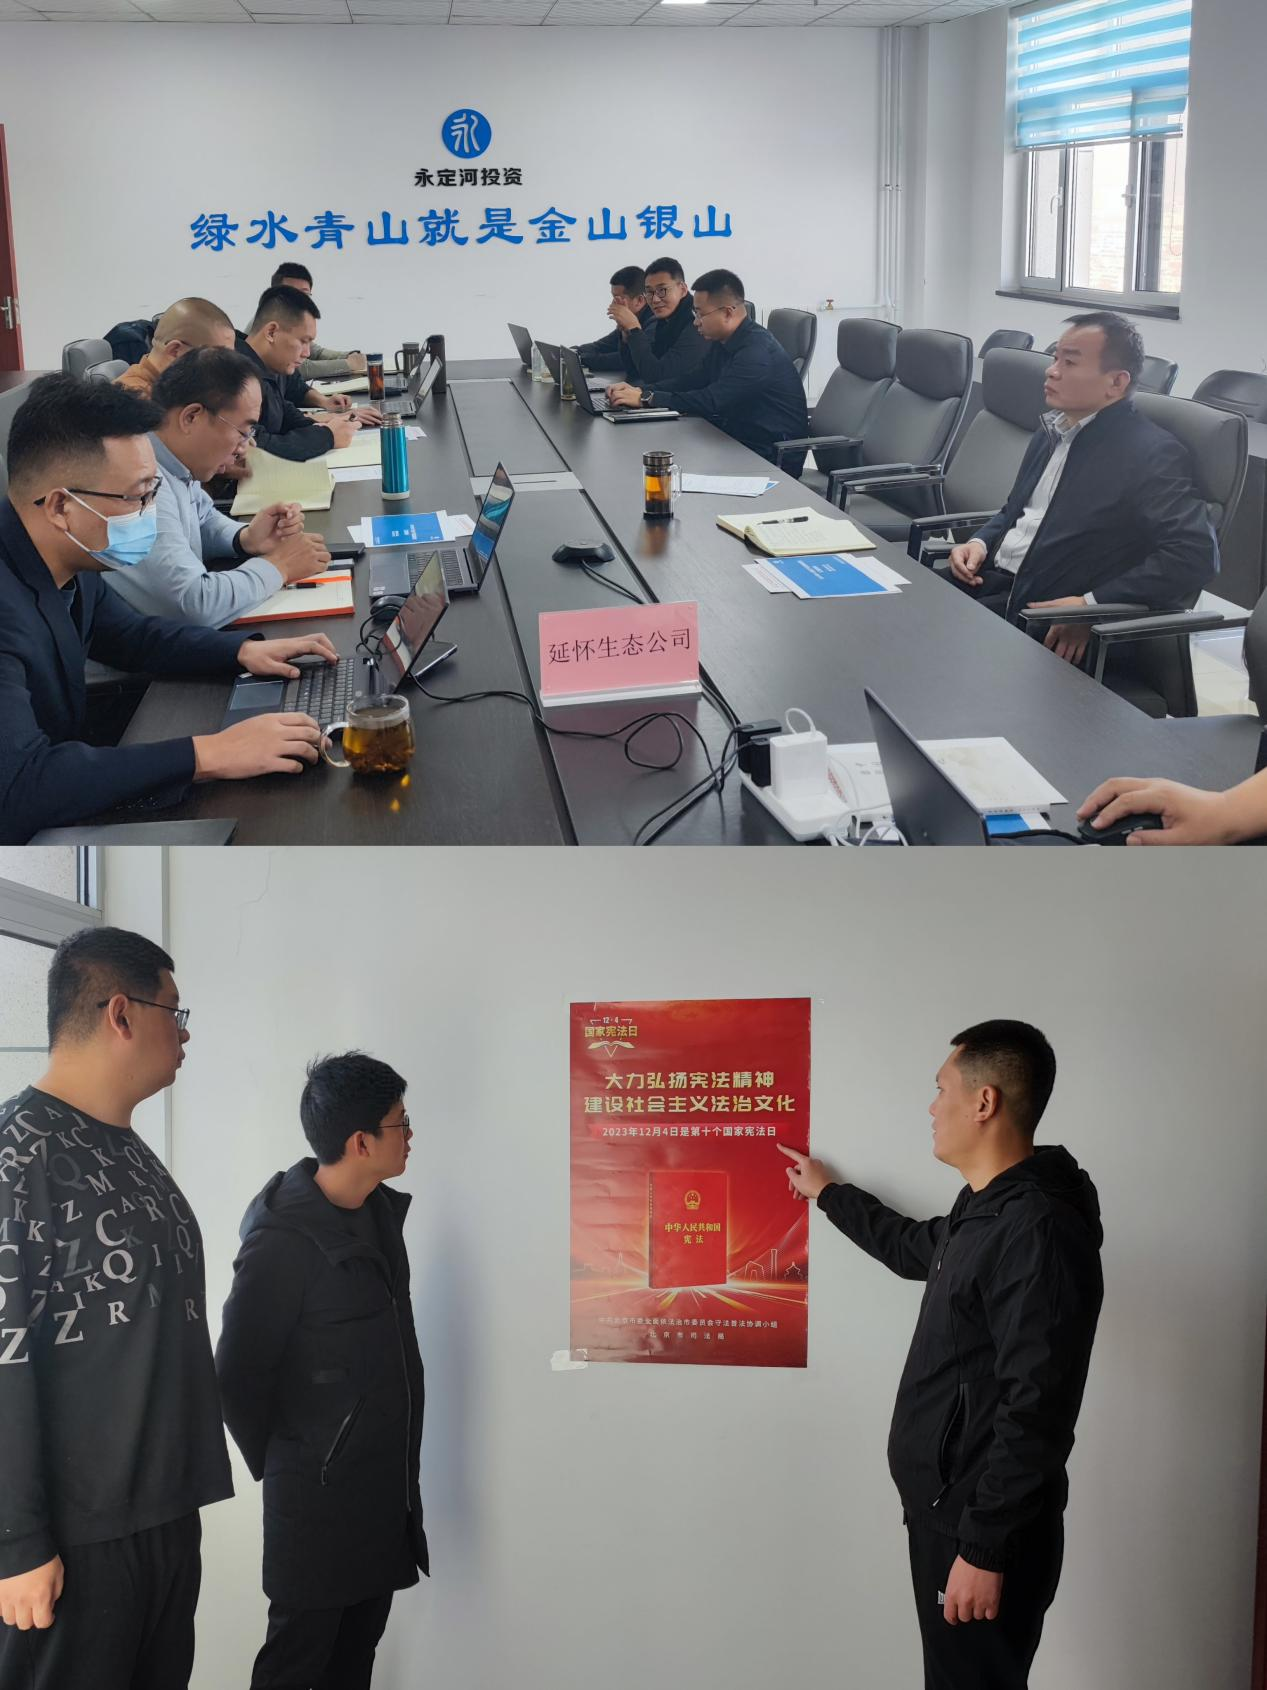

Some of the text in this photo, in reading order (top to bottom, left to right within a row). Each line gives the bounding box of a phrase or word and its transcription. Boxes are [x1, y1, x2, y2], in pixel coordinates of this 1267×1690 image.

[414, 167, 523, 188] 永定河投资
[190, 204, 733, 251] 绿水青山就是金山银山
[548, 627, 691, 665] 延怀生态公司
[585, 1026, 638, 1038] 国家宪法日
[604, 1071, 775, 1090] 大力弘扬宪法精神
[584, 1094, 796, 1113] 建设社会主义法治文化
[602, 1126, 777, 1137] 2023年12月4日是第十个国家宪法日
[664, 1222, 721, 1233] 中华人民共和国
